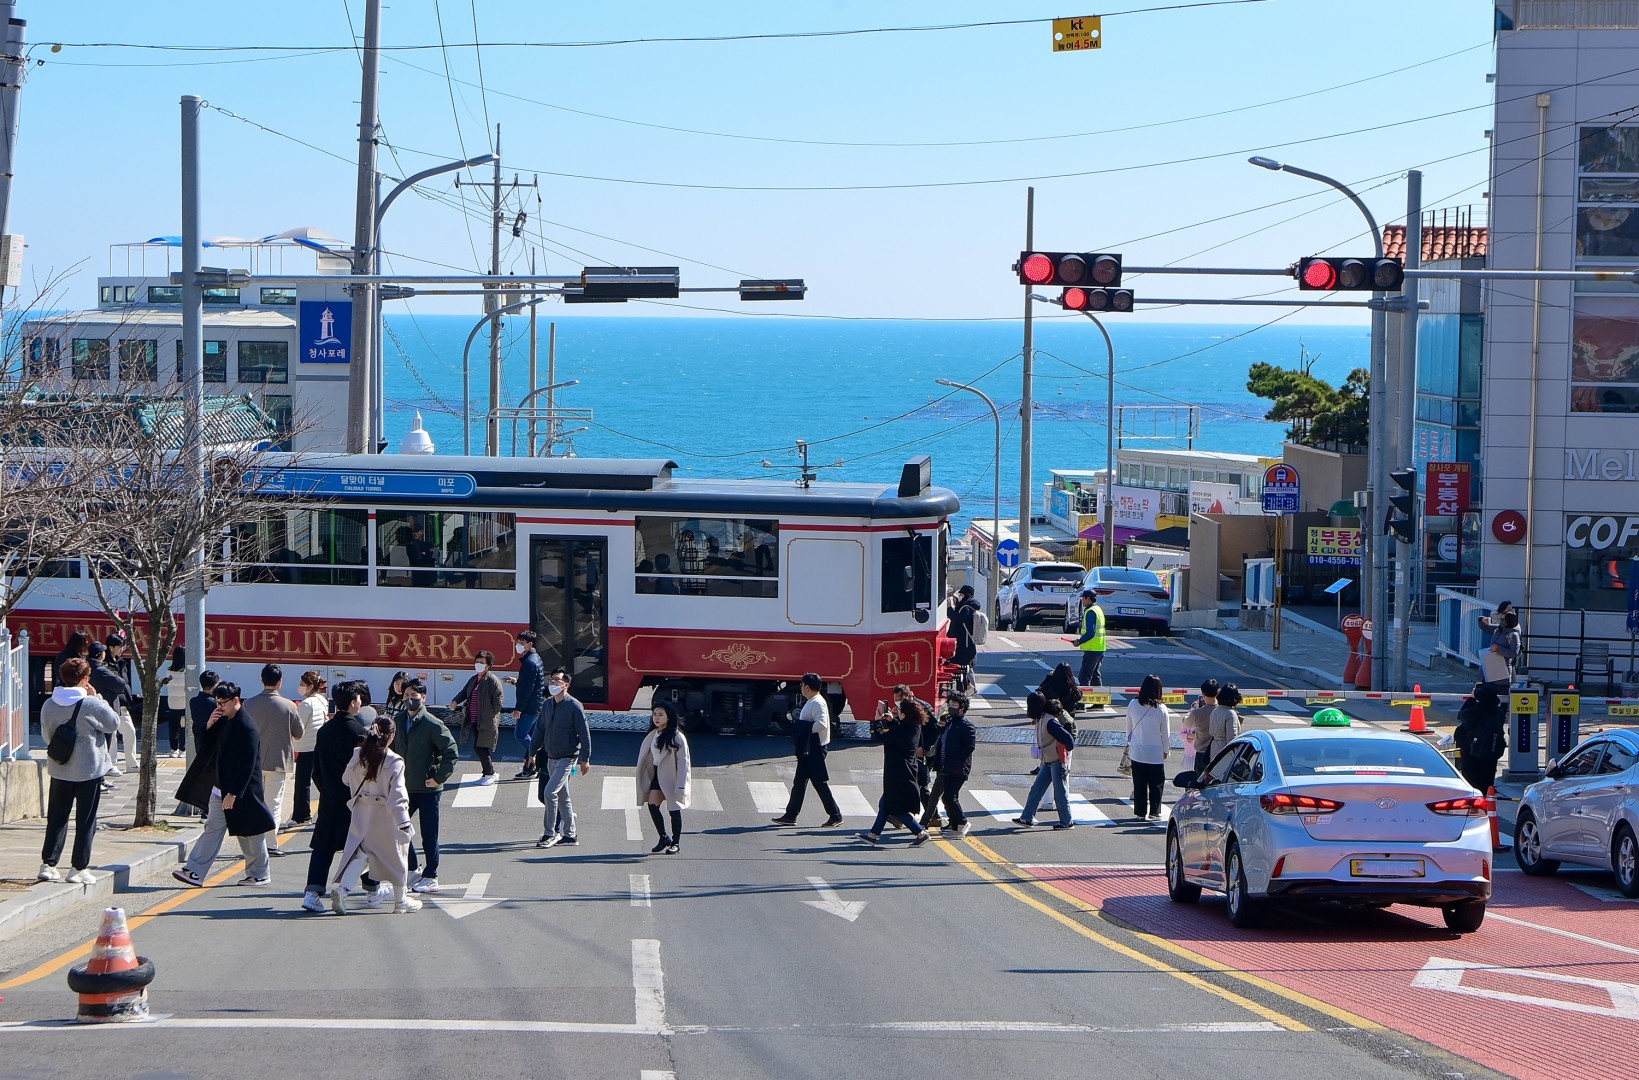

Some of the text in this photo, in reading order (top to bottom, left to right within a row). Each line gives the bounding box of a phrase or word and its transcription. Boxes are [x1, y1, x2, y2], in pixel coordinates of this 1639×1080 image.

[1071, 19, 1083, 30] kt
[308, 347, 346, 359] 청사포레
[1564, 448, 1636, 481] Mel
[340, 475, 385, 486] 달맞이 터널
[438, 477, 455, 488] 미포
[1435, 473, 1460, 516] 부동산
[377, 631, 475, 660] PARK
[911, 651, 922, 675] 1
